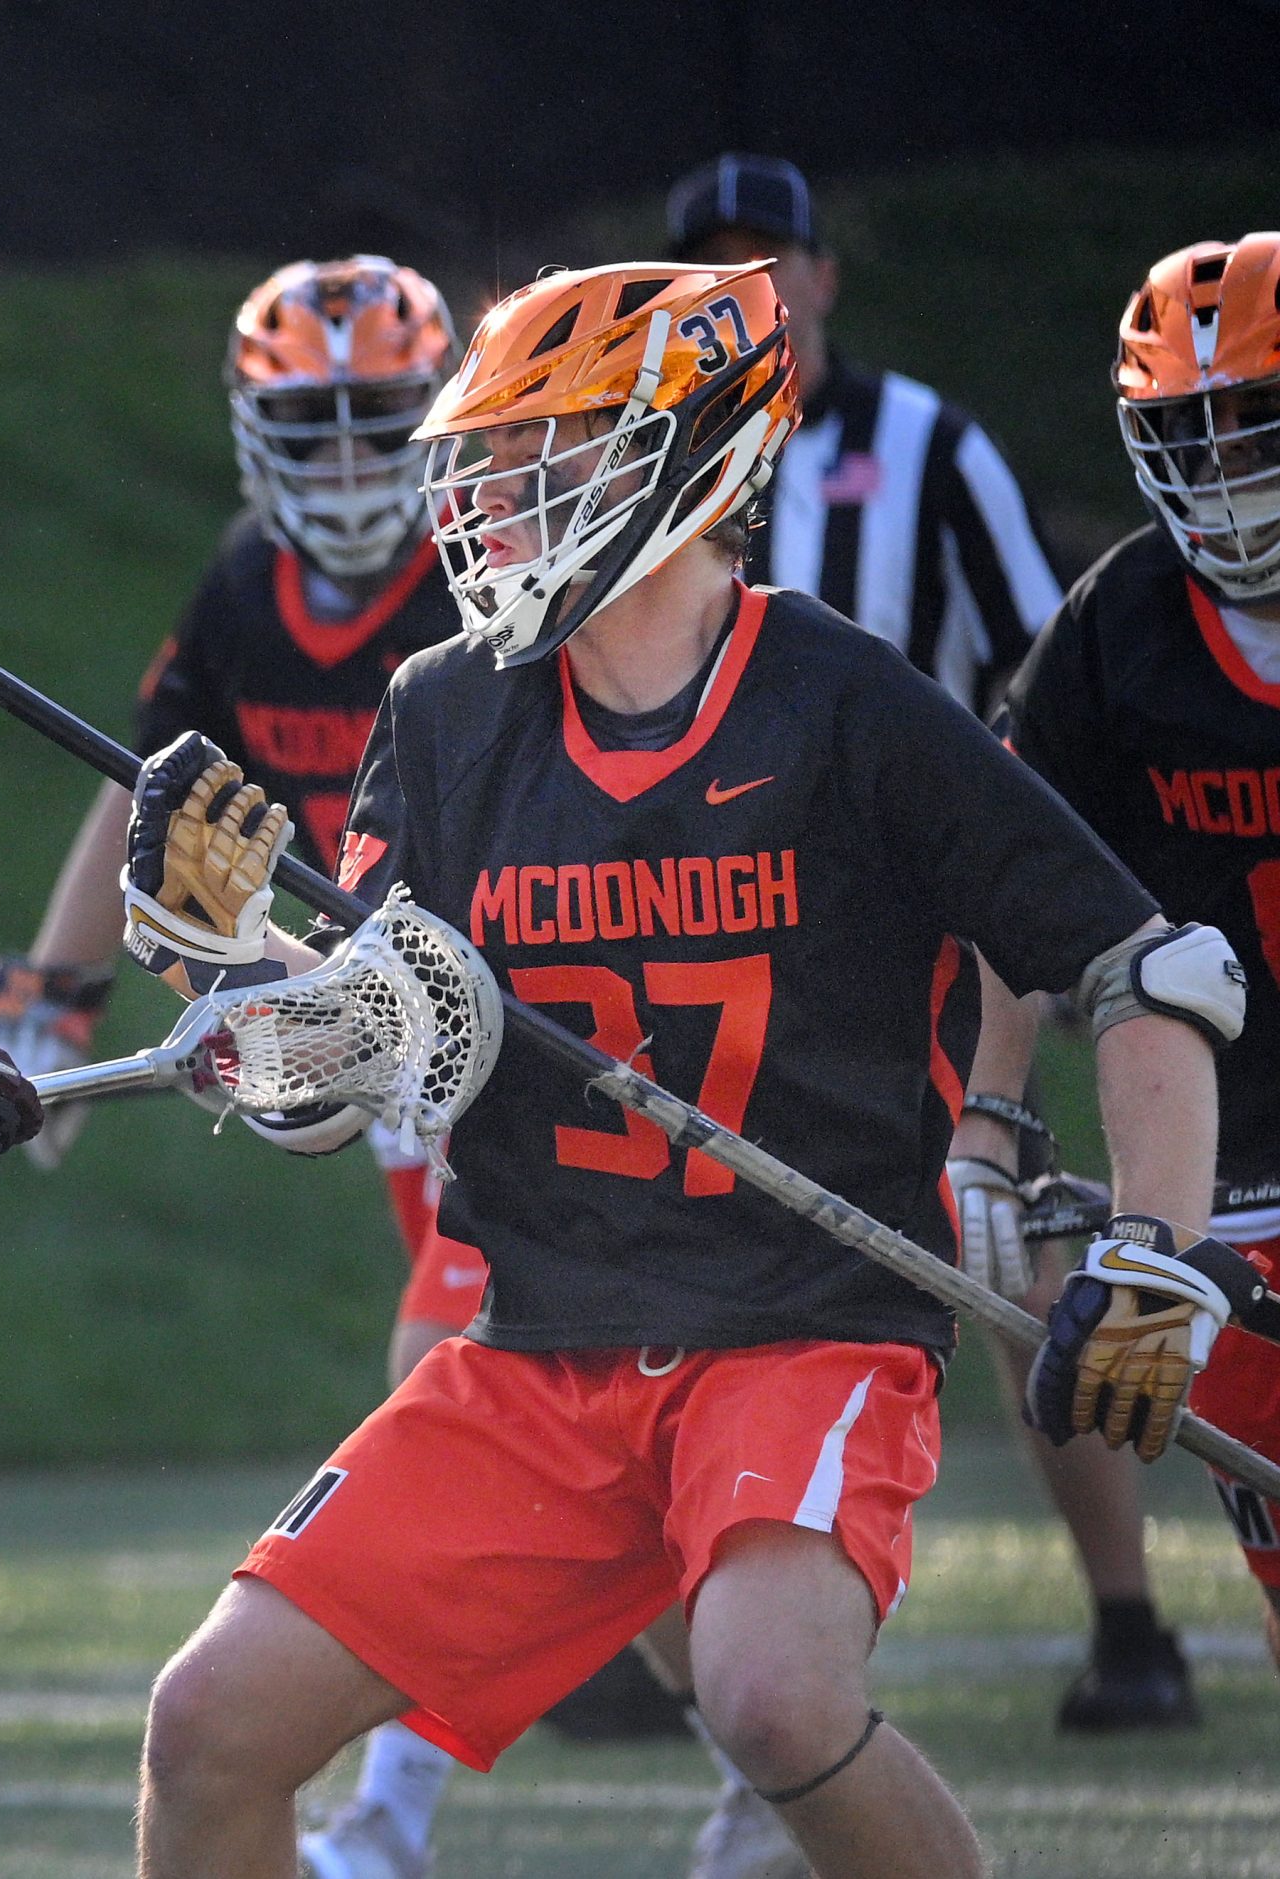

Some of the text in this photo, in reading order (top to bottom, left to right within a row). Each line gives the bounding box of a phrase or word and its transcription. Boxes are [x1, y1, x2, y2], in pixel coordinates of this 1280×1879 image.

[677, 293, 758, 377] 37
[470, 849, 798, 947] MCDONOGH
[508, 953, 772, 1197] 37
